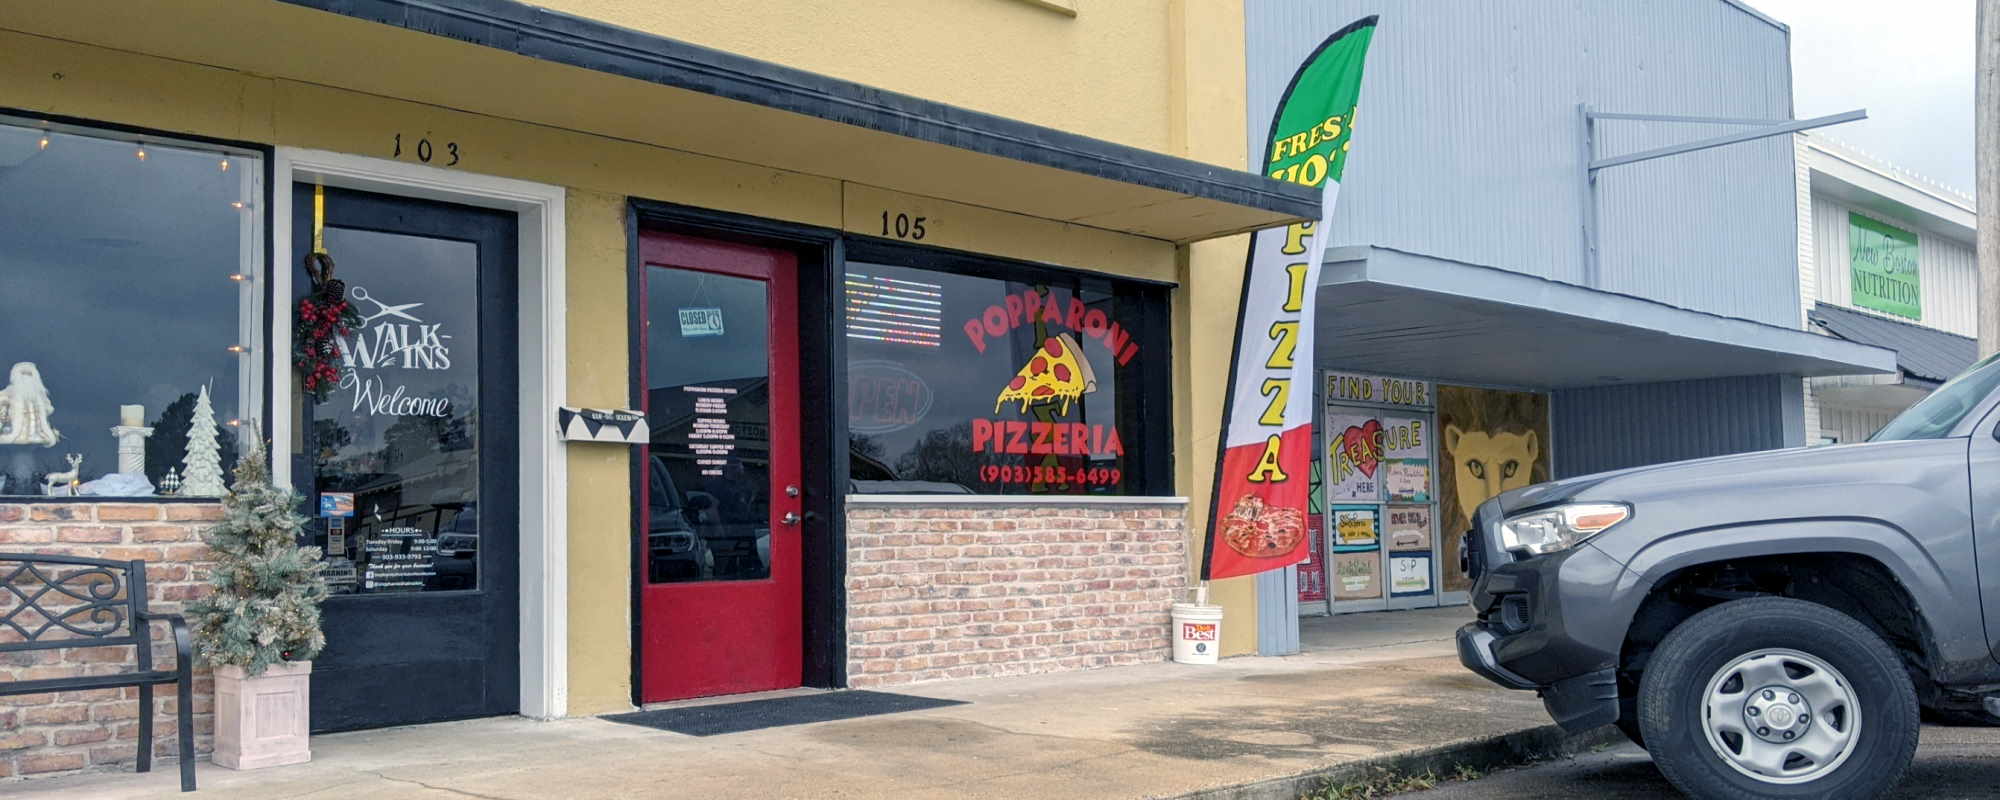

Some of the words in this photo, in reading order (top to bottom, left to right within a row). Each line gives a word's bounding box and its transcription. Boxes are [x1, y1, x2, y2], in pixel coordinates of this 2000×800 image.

[394, 133, 459, 166] 103
[882, 210, 926, 240] 105
[1853, 225, 1879, 266] New
[1853, 268, 1919, 306] NUTRITION
[963, 289, 1139, 367] POPPARONI
[401, 343, 451, 370] INS
[1246, 219, 1314, 482] PIZZA
[340, 368, 449, 417] Welcome
[1327, 375, 1373, 400] FIND
[1381, 379, 1425, 405] YOUR
[970, 418, 1125, 456] PIZZERIA
[1329, 420, 1422, 486] TREASURE
[980, 464, 1121, 484] (903)585-6499
[1357, 481, 1375, 494] HERE
[1184, 625, 1215, 640] Best
